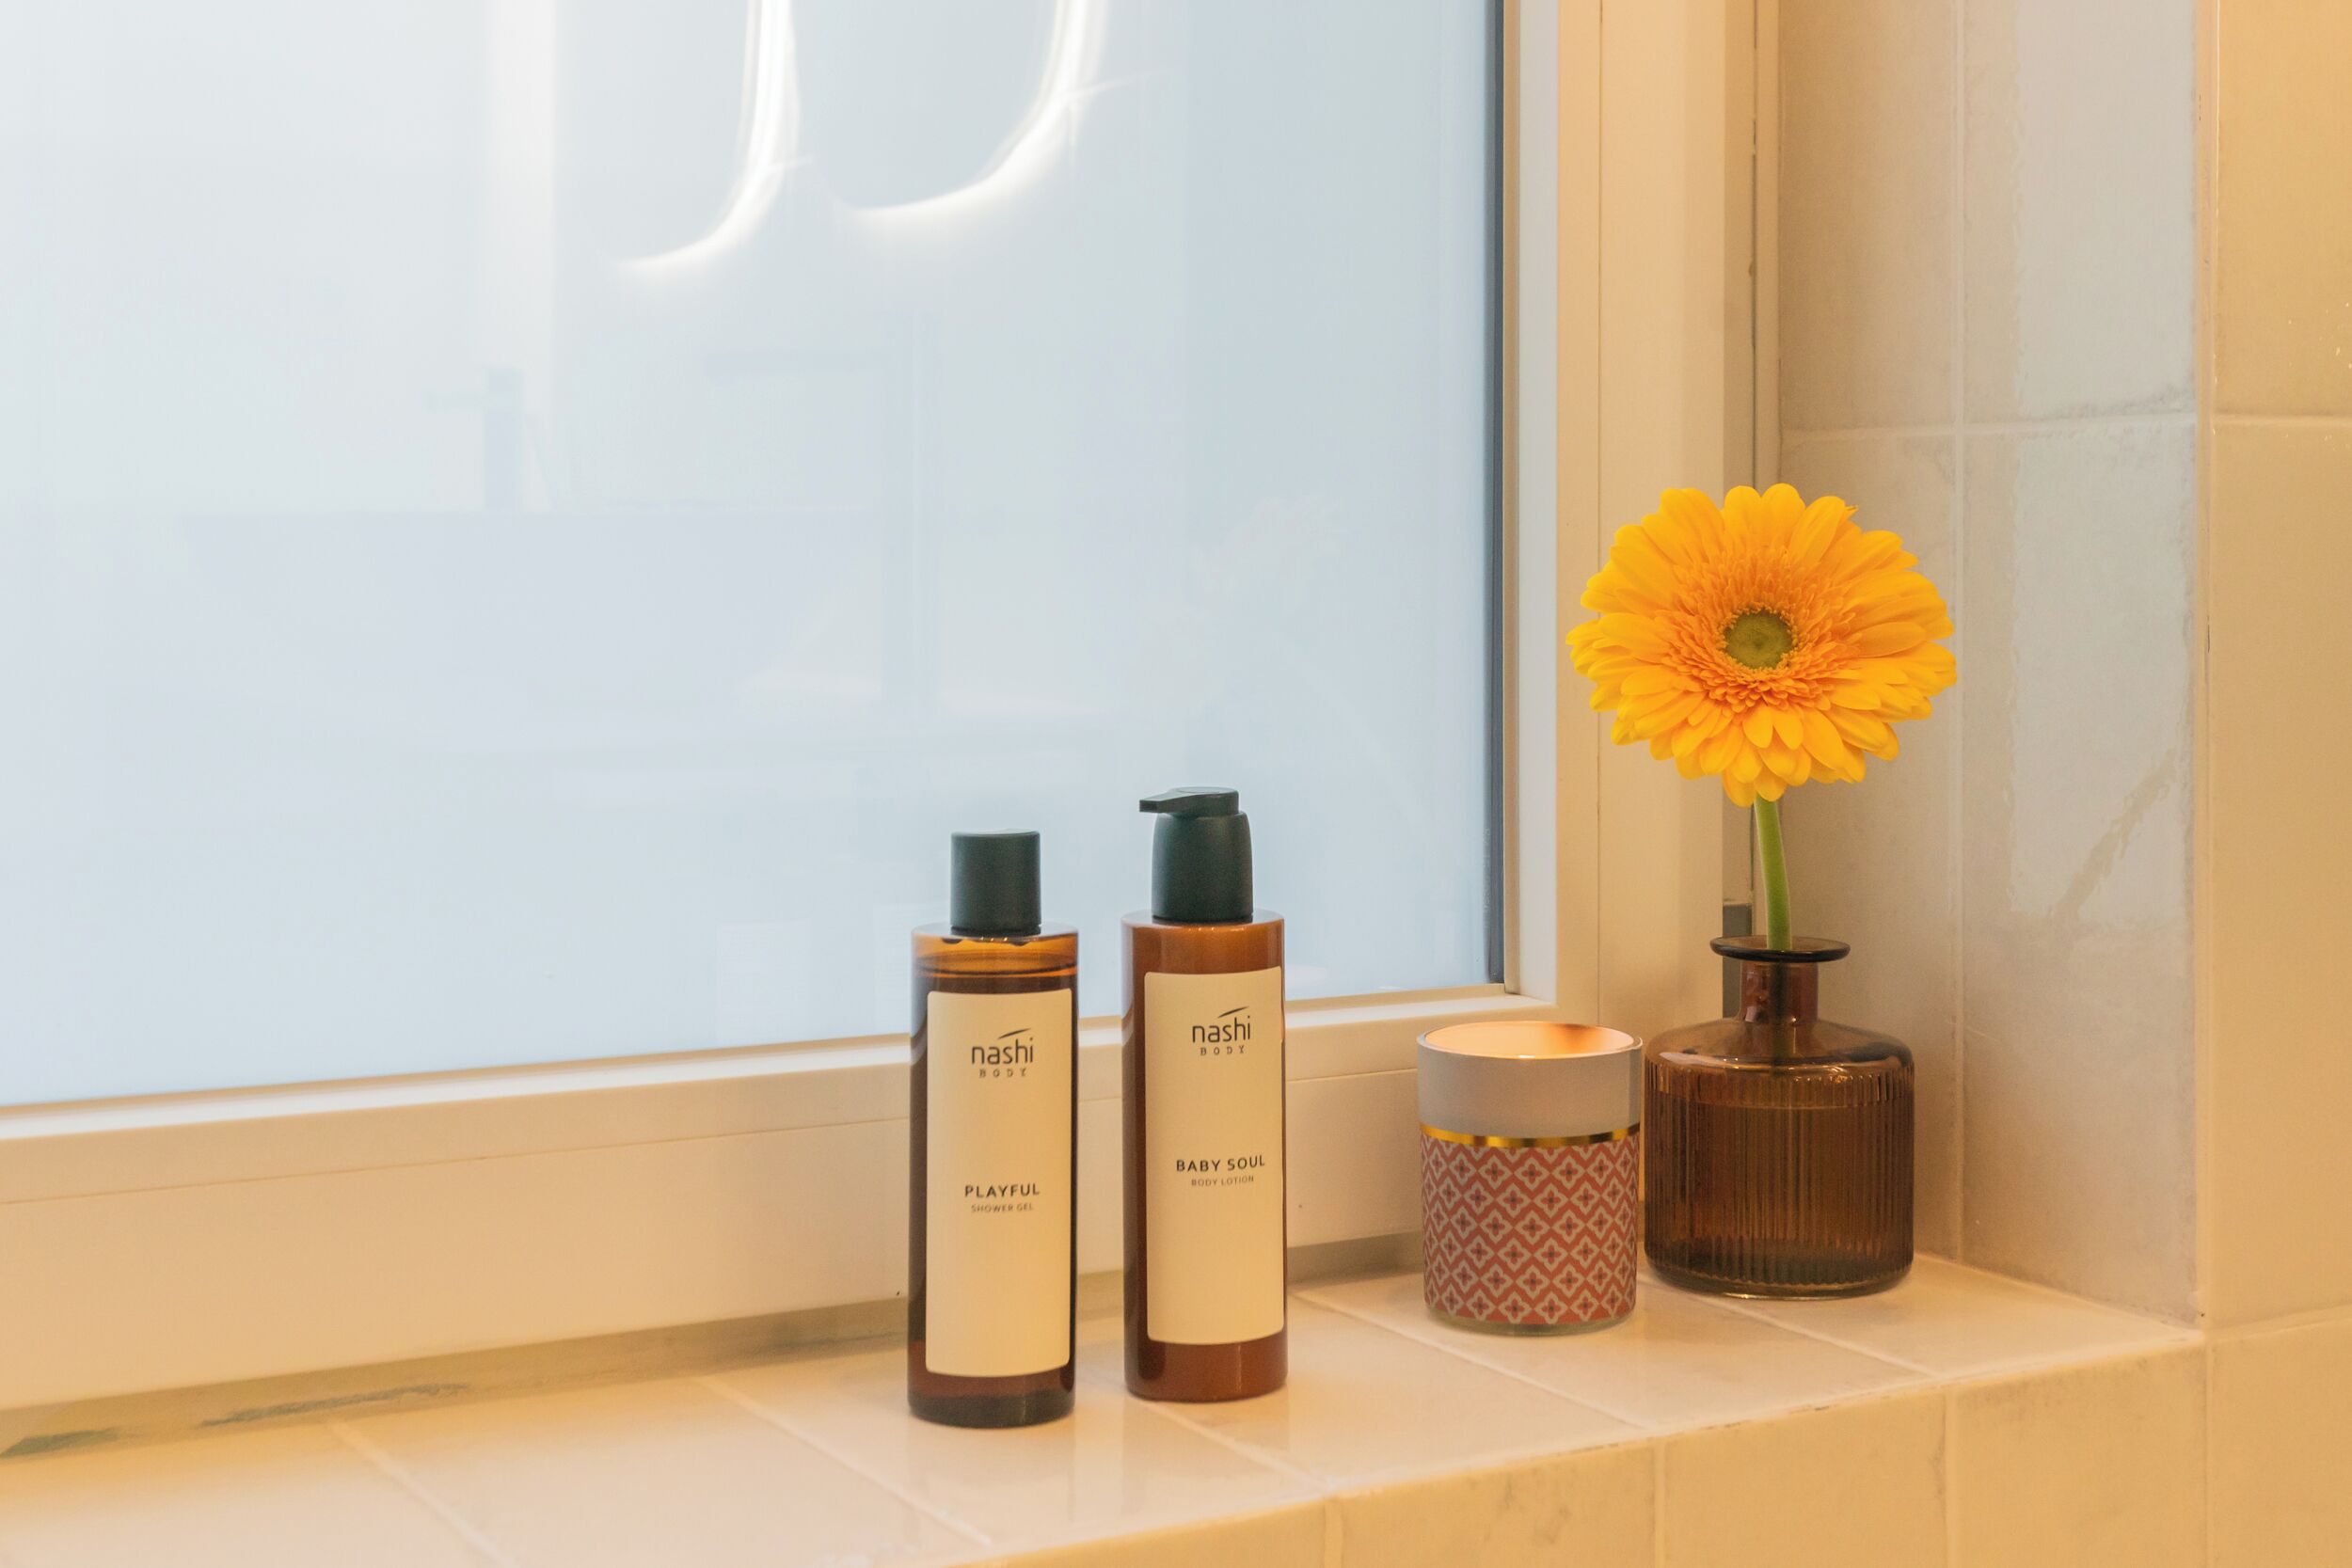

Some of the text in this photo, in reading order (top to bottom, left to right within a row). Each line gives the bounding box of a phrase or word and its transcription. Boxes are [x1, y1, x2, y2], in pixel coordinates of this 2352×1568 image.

[1192, 1015, 1250, 1043] nashi
[972, 1037, 1034, 1065] nashi
[1200, 1045, 1246, 1056] BODY
[979, 1068, 1026, 1078] BODY
[1176, 1154, 1265, 1173] BABY SOUL
[1191, 1175, 1254, 1187] BODY LOTION
[964, 1182, 1041, 1198] PLAYFUL
[971, 1202, 1034, 1213] SHOWER GEL
